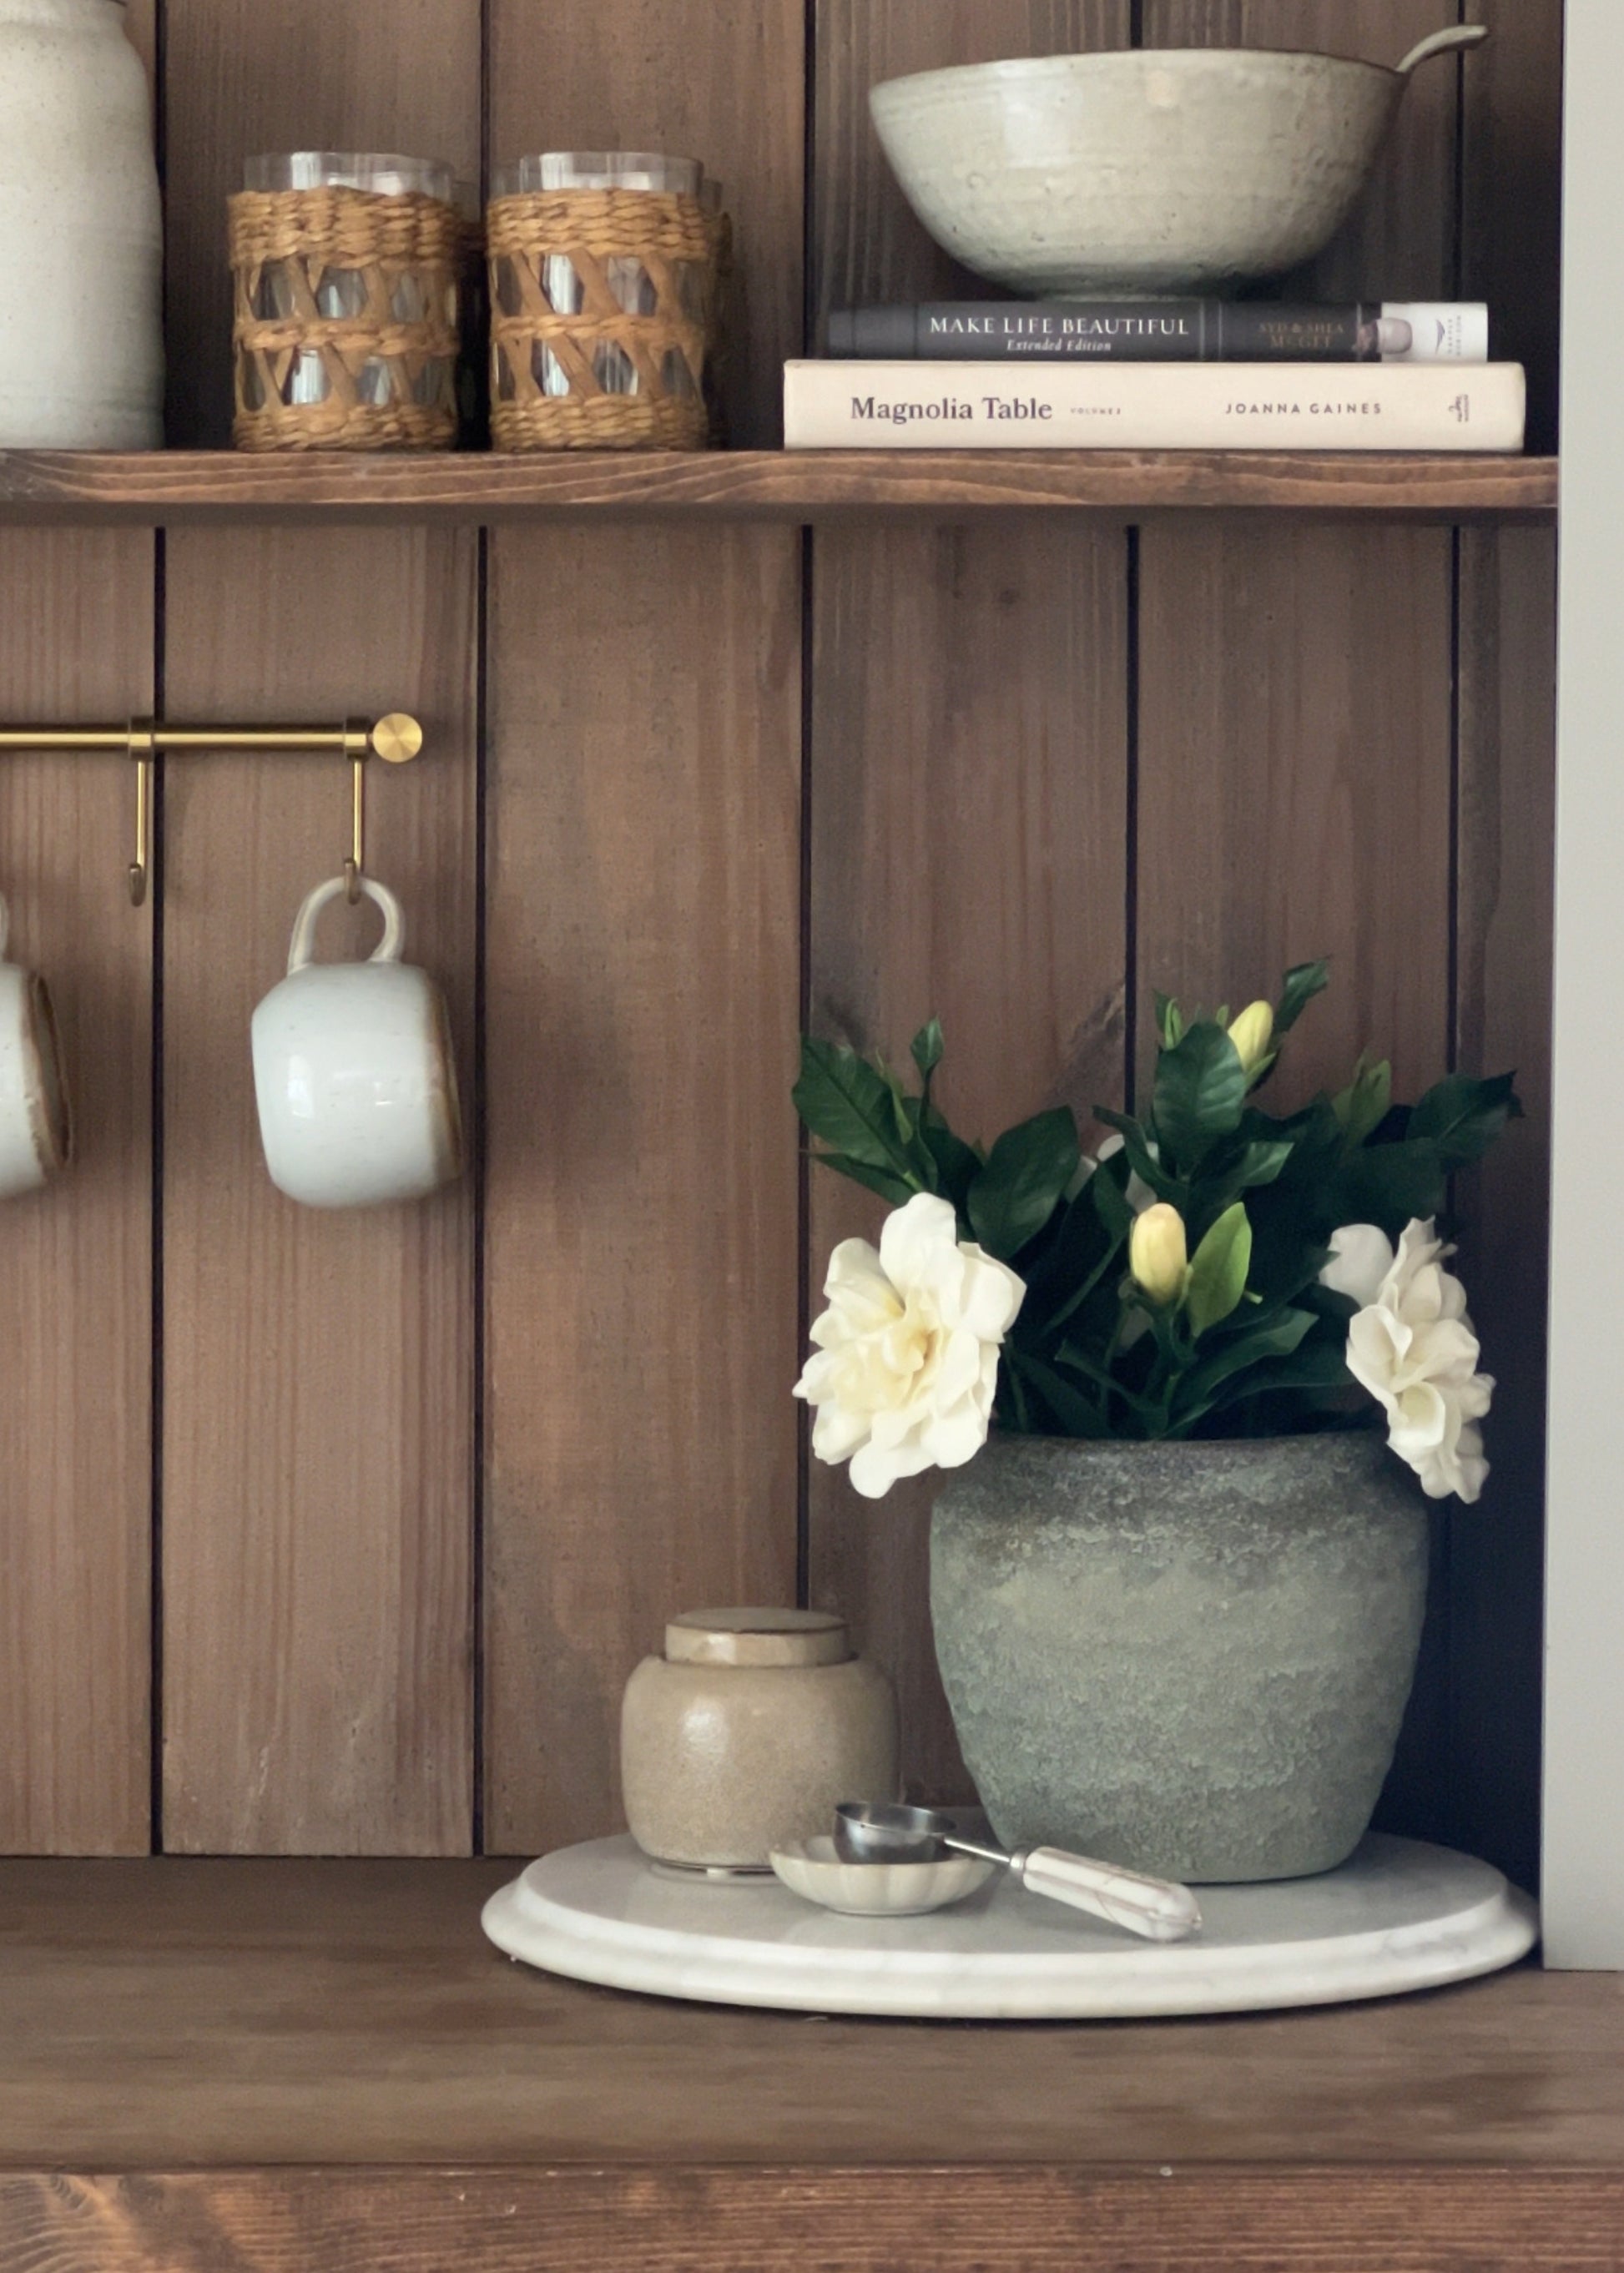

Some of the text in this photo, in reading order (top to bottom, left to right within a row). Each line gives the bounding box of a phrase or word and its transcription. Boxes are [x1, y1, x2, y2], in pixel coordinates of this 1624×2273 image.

[930, 317, 1189, 335] MAKE LIFE BEAUTIFUL
[1006, 338, 1112, 351] Extended Edition
[850, 397, 973, 423] Magnolia
[982, 397, 1052, 420] Table
[1226, 403, 1381, 414] JOANNA GAINES
